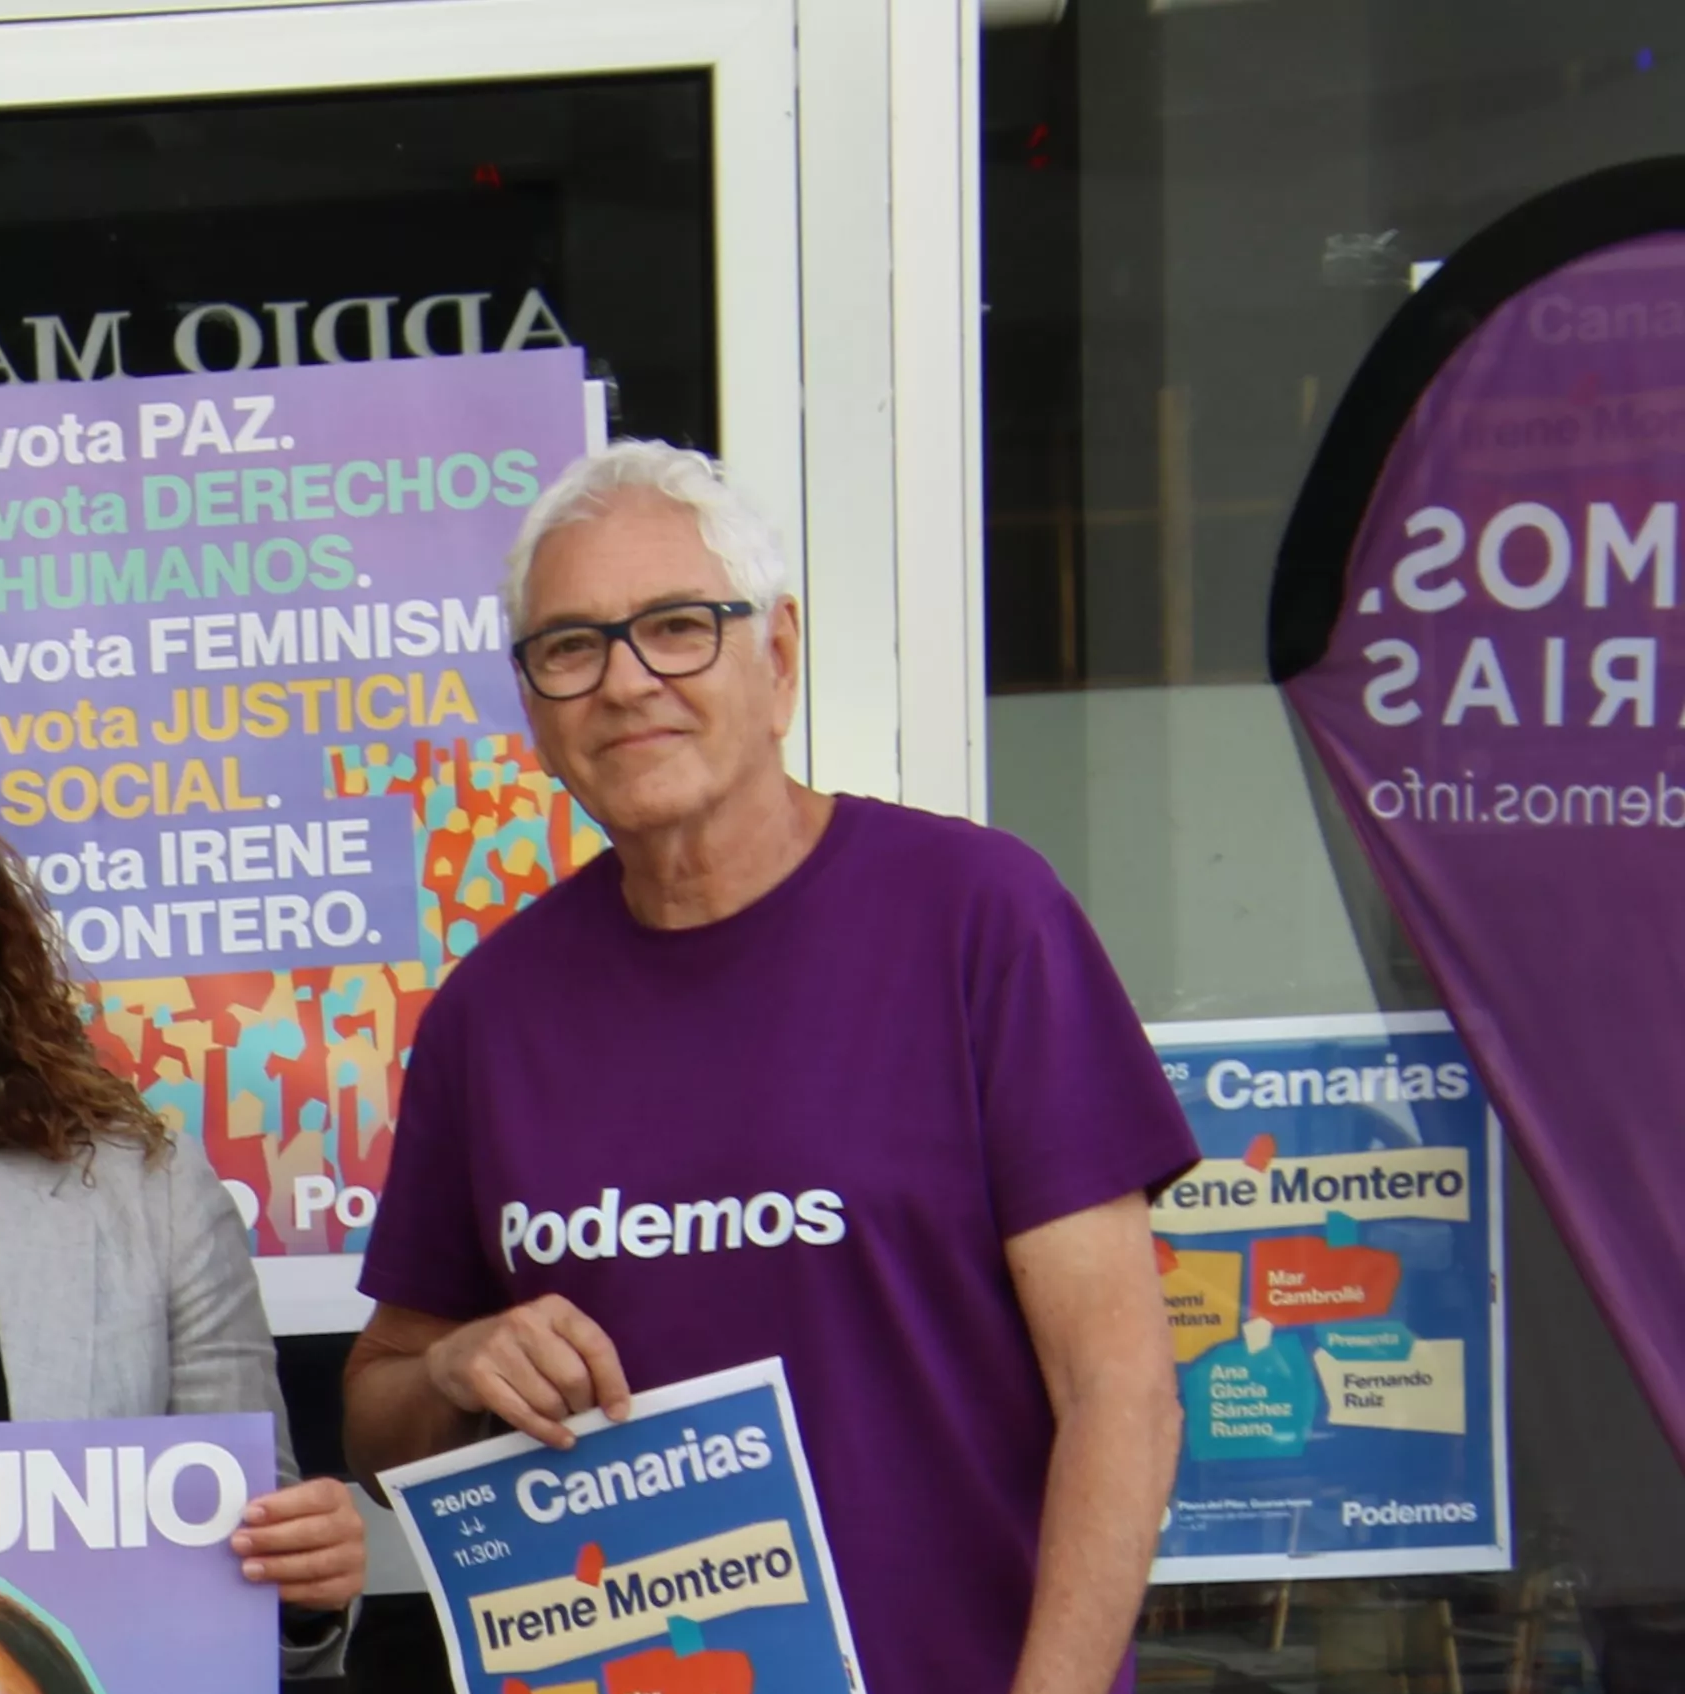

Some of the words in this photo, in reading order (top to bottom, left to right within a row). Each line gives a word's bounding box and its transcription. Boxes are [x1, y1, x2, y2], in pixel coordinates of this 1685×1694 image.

[138, 396, 295, 460] PAZ.
[143, 449, 540, 533] DERECHOS
[149, 595, 510, 676] FEMINISM
[152, 670, 478, 745] JUSTICIA
[0, 757, 282, 826] SOCIAL.
[159, 818, 373, 888] IRENE
[53, 890, 382, 964] ONTERO.
[1206, 1054, 1471, 1110] Canarias
[1270, 1167, 1464, 1204] Montero
[501, 1188, 846, 1274] Podemos
[1268, 1271, 1304, 1287] Mar
[1268, 1286, 1365, 1307] Cambrollé
[1210, 1364, 1248, 1380] Ana
[1210, 1383, 1268, 1400] Gloria
[1344, 1371, 1433, 1390] Fernando
[1344, 1394, 1384, 1409] Ruiz
[1210, 1421, 1274, 1438] Ruano
[515, 1426, 772, 1524] Canarias
[432, 1484, 497, 1517] 26/05
[1341, 1500, 1478, 1526] Podemos
[453, 1538, 511, 1568] 11.30h
[482, 1596, 598, 1651] Irene
[604, 1546, 793, 1620] Montero
